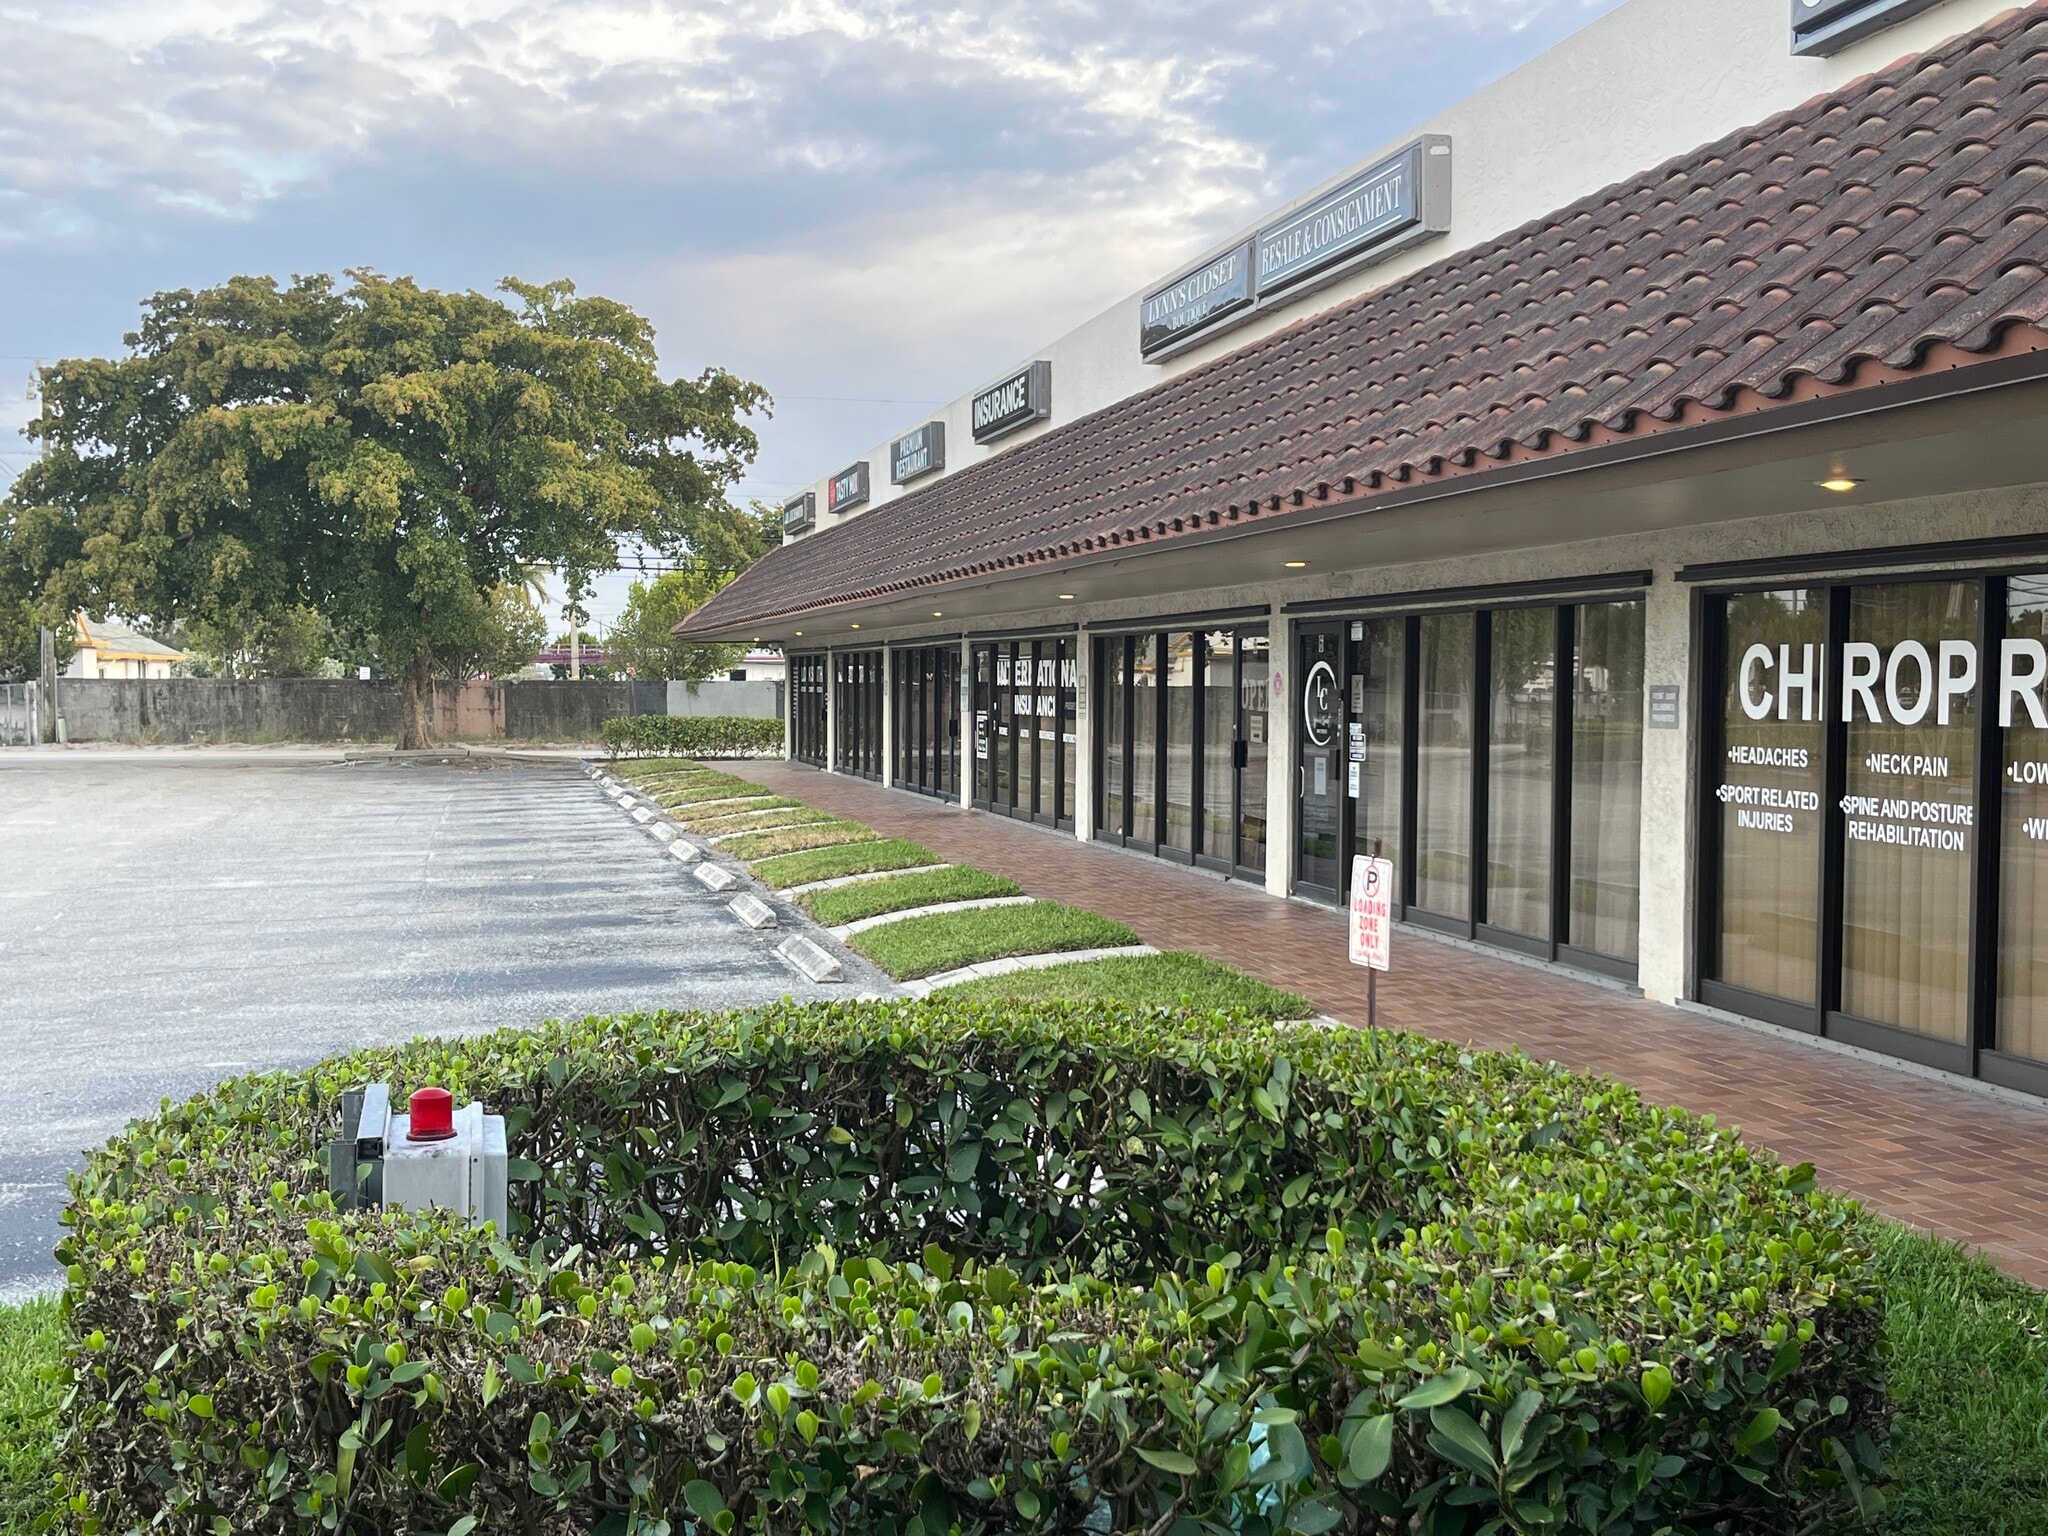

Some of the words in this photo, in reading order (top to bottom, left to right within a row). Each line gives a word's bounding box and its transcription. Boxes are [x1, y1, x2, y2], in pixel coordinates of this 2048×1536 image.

[1262, 230, 1302, 276] RESALE
[1303, 225, 1313, 256] &
[1314, 175, 1402, 250] CONSIGNMENT
[1148, 285, 1186, 323] LYNN'S
[1188, 255, 1236, 303] CLOSET
[1172, 300, 1208, 330] BOUTIQUE
[974, 376, 1026, 430] INSURANCE
[1731, 746, 1808, 768] HEADACHES
[1870, 753, 1911, 775] NECK
[1913, 756, 1948, 777] PAIN
[1719, 784, 1760, 805] SPORT
[1761, 787, 1819, 811] RELATED
[1737, 809, 1794, 833] INJURIES
[1842, 795, 1879, 818] SPINE
[1880, 798, 1909, 821] AND
[1911, 800, 1973, 826] POSTURE
[1848, 820, 1965, 852] REHABILITATION
[1366, 871, 1378, 891] P
[1353, 898, 1387, 917] LOADING
[1359, 916, 1378, 932] ZONE
[1360, 933, 1379, 949] ONLY
